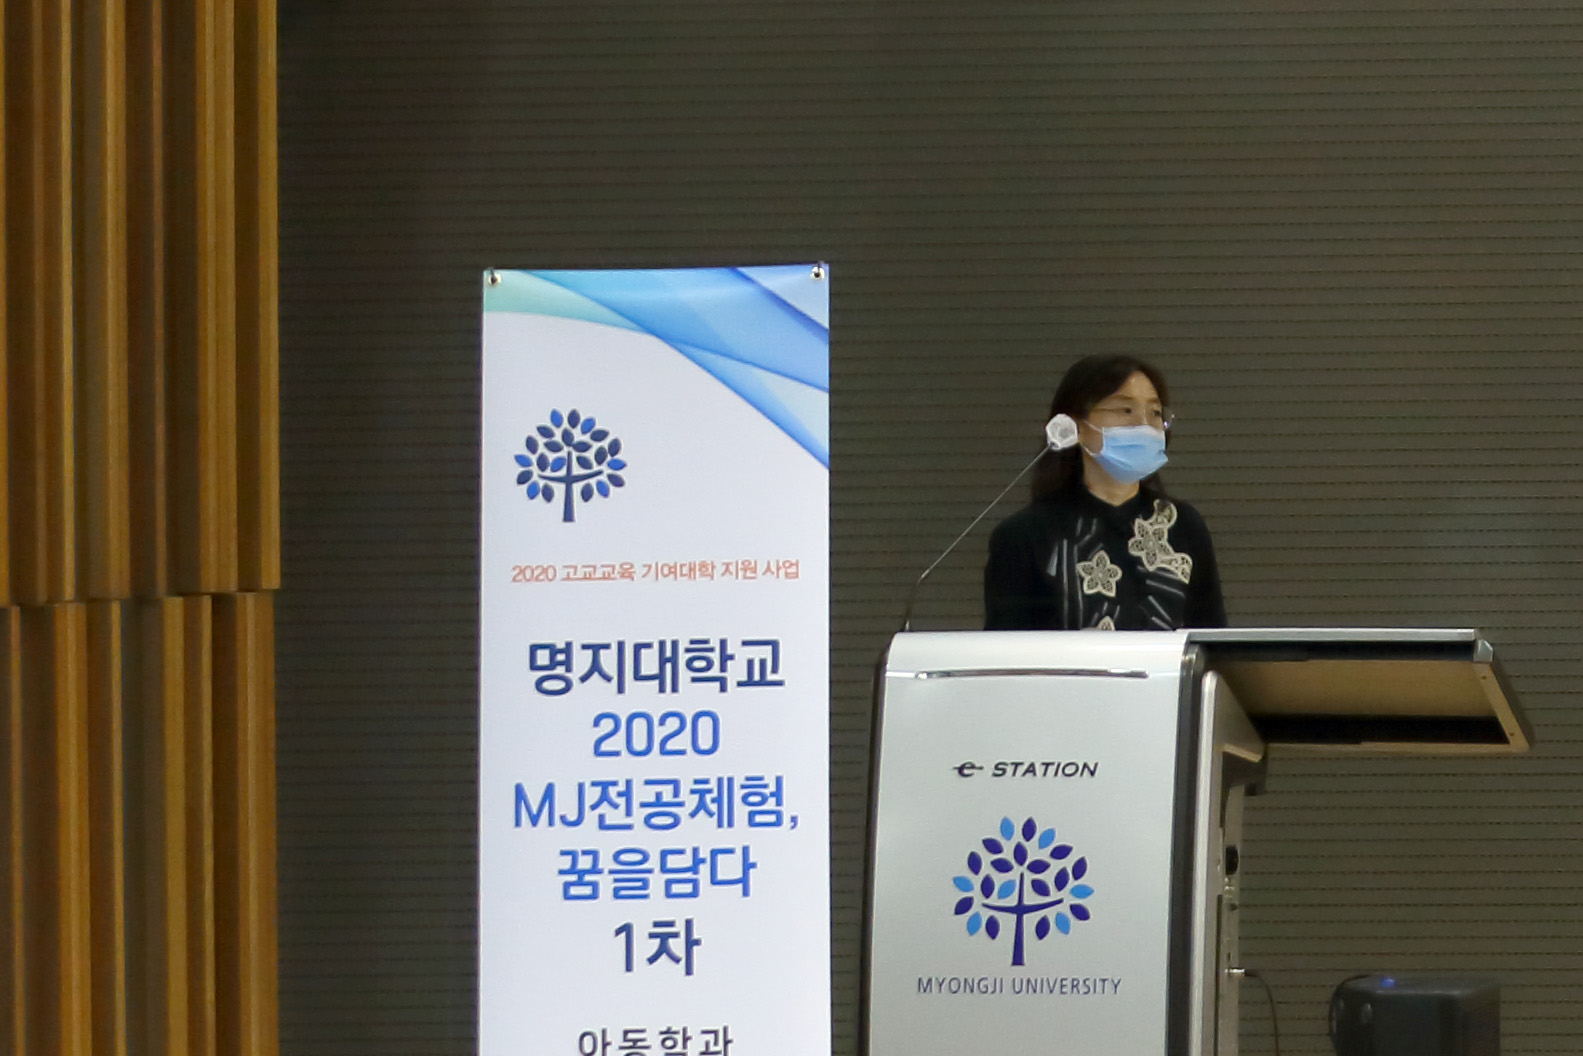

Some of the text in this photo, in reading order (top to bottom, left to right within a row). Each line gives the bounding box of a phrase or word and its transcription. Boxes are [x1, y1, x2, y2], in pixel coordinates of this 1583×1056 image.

[511, 559, 800, 582] 2020 고교교육 기여대학 지원 사업
[528, 638, 786, 697] 명지대학교
[592, 709, 721, 758] 2020
[991, 762, 1099, 778] STATION
[513, 775, 799, 831] MJ전공체험,
[556, 845, 758, 901] 꿈을담다
[613, 918, 702, 977] 1차
[917, 977, 1122, 995] MYONGJI UNIVERSITY
